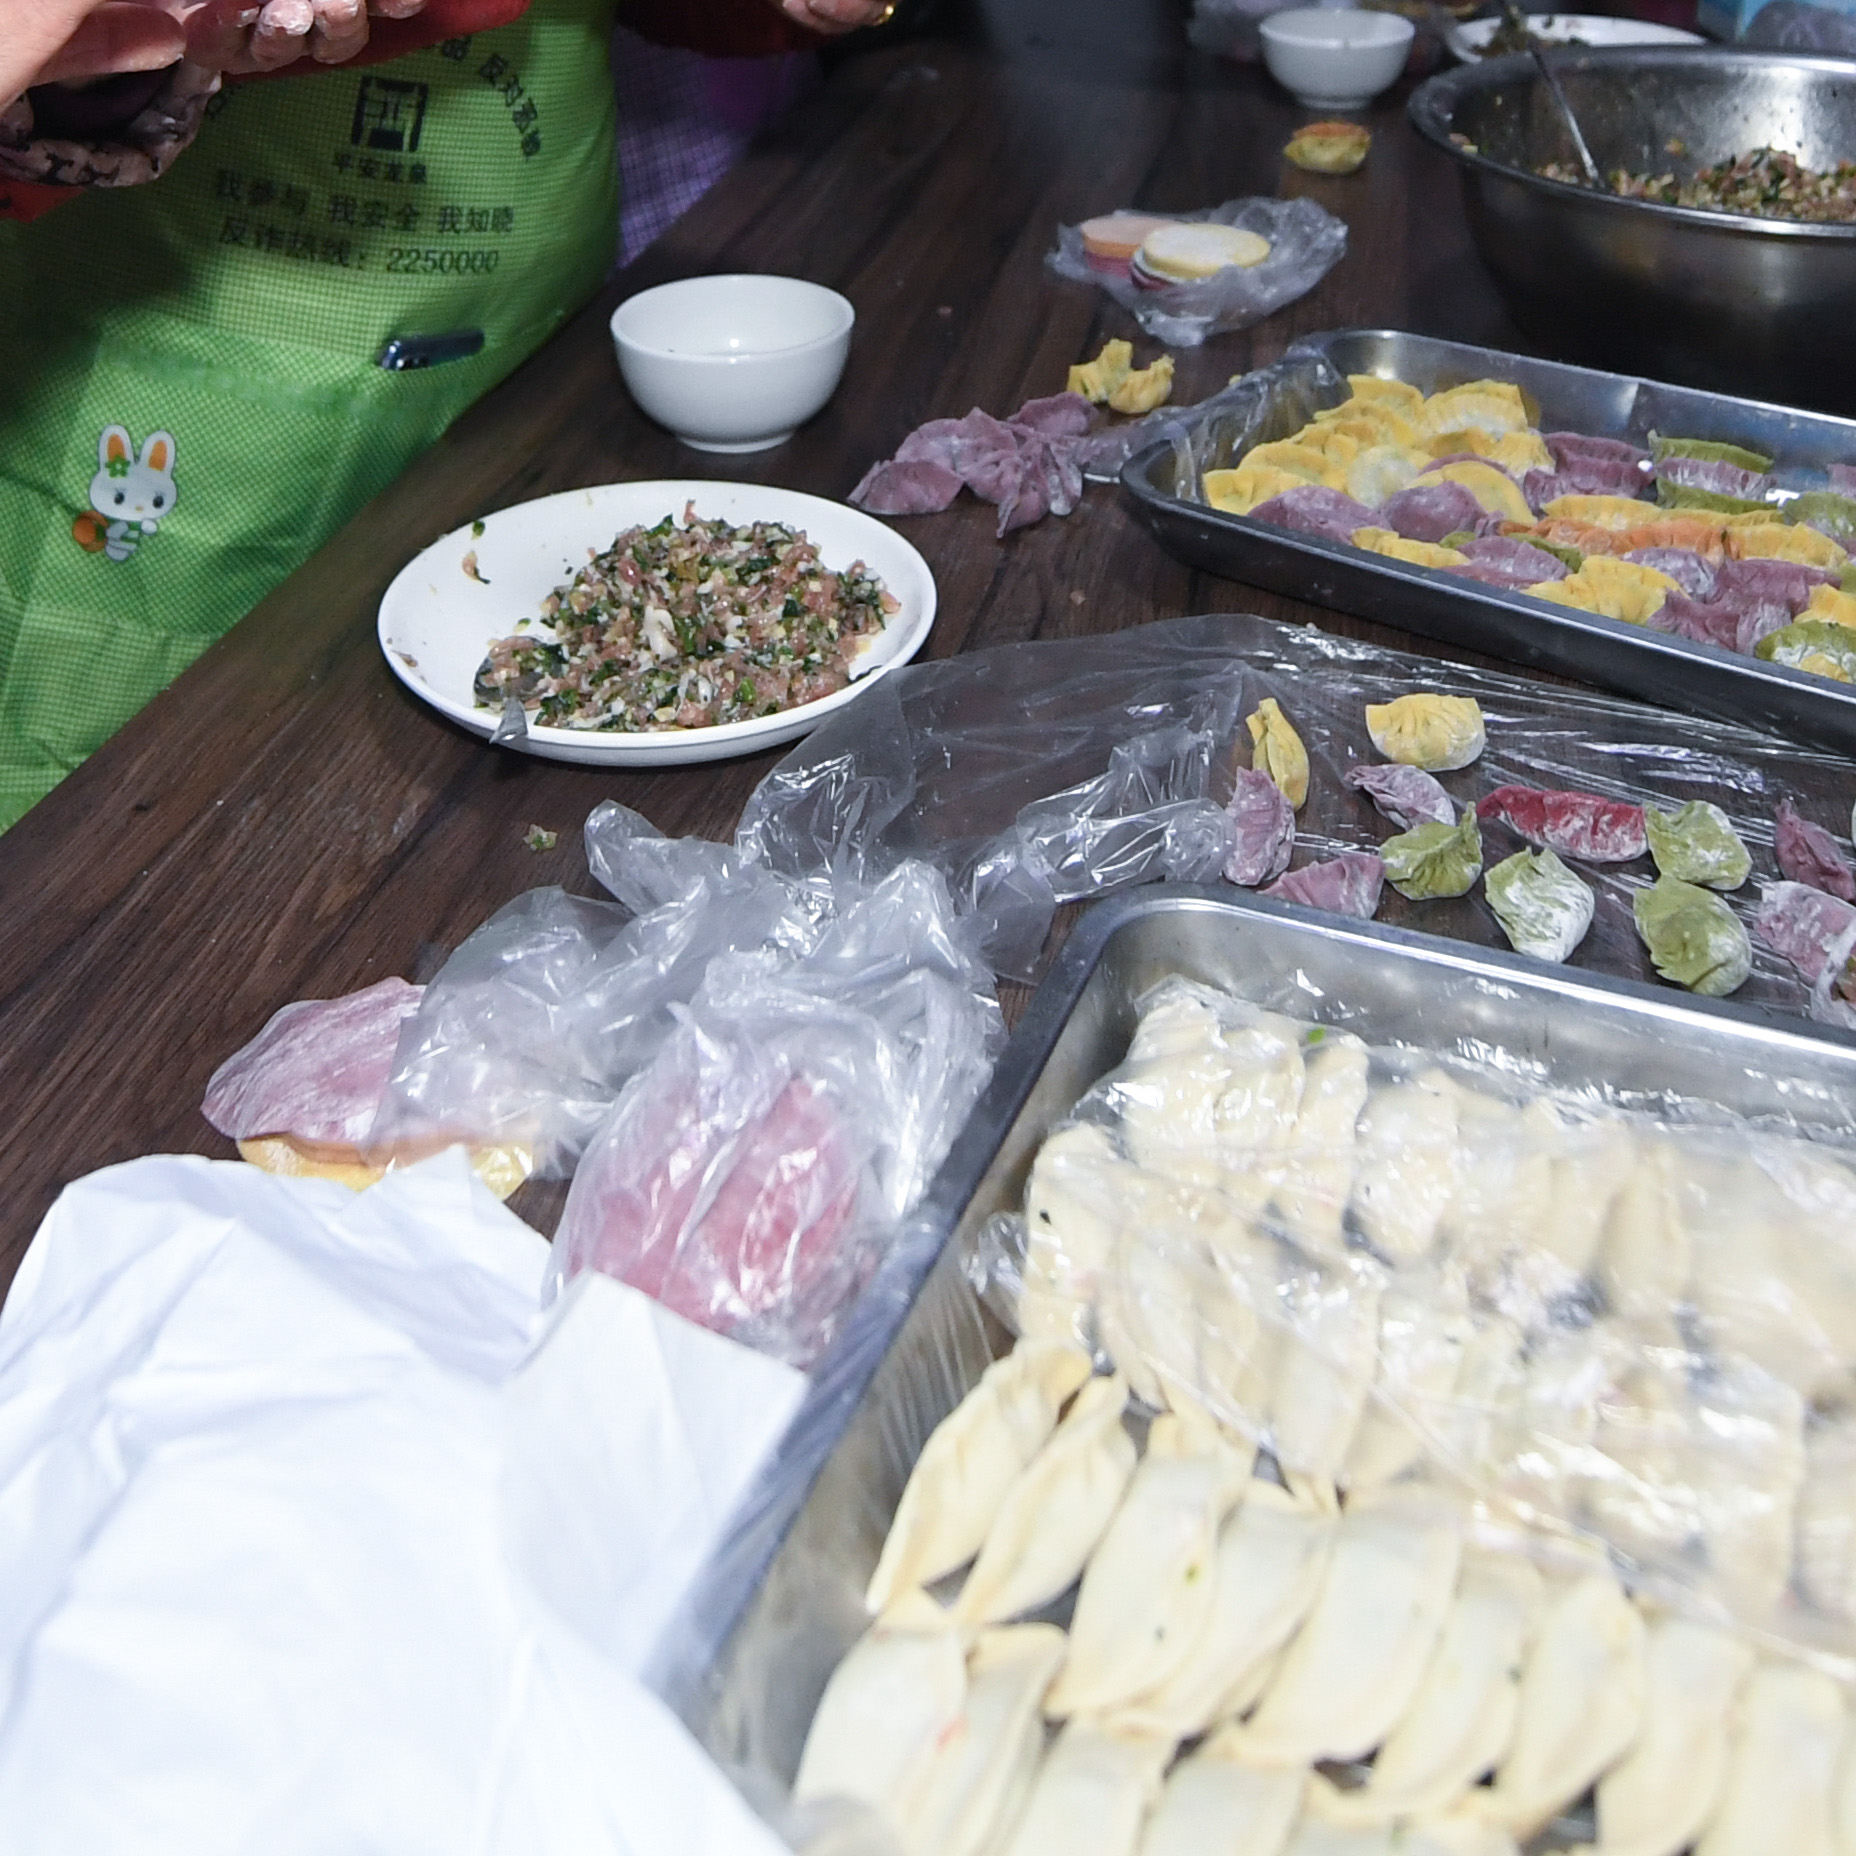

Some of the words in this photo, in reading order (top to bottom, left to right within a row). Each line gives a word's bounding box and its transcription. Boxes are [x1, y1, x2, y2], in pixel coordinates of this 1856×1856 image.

[328, 194, 422, 232] 我安全
[438, 204, 515, 234] 我知晓
[385, 246, 500, 275] 2250000
